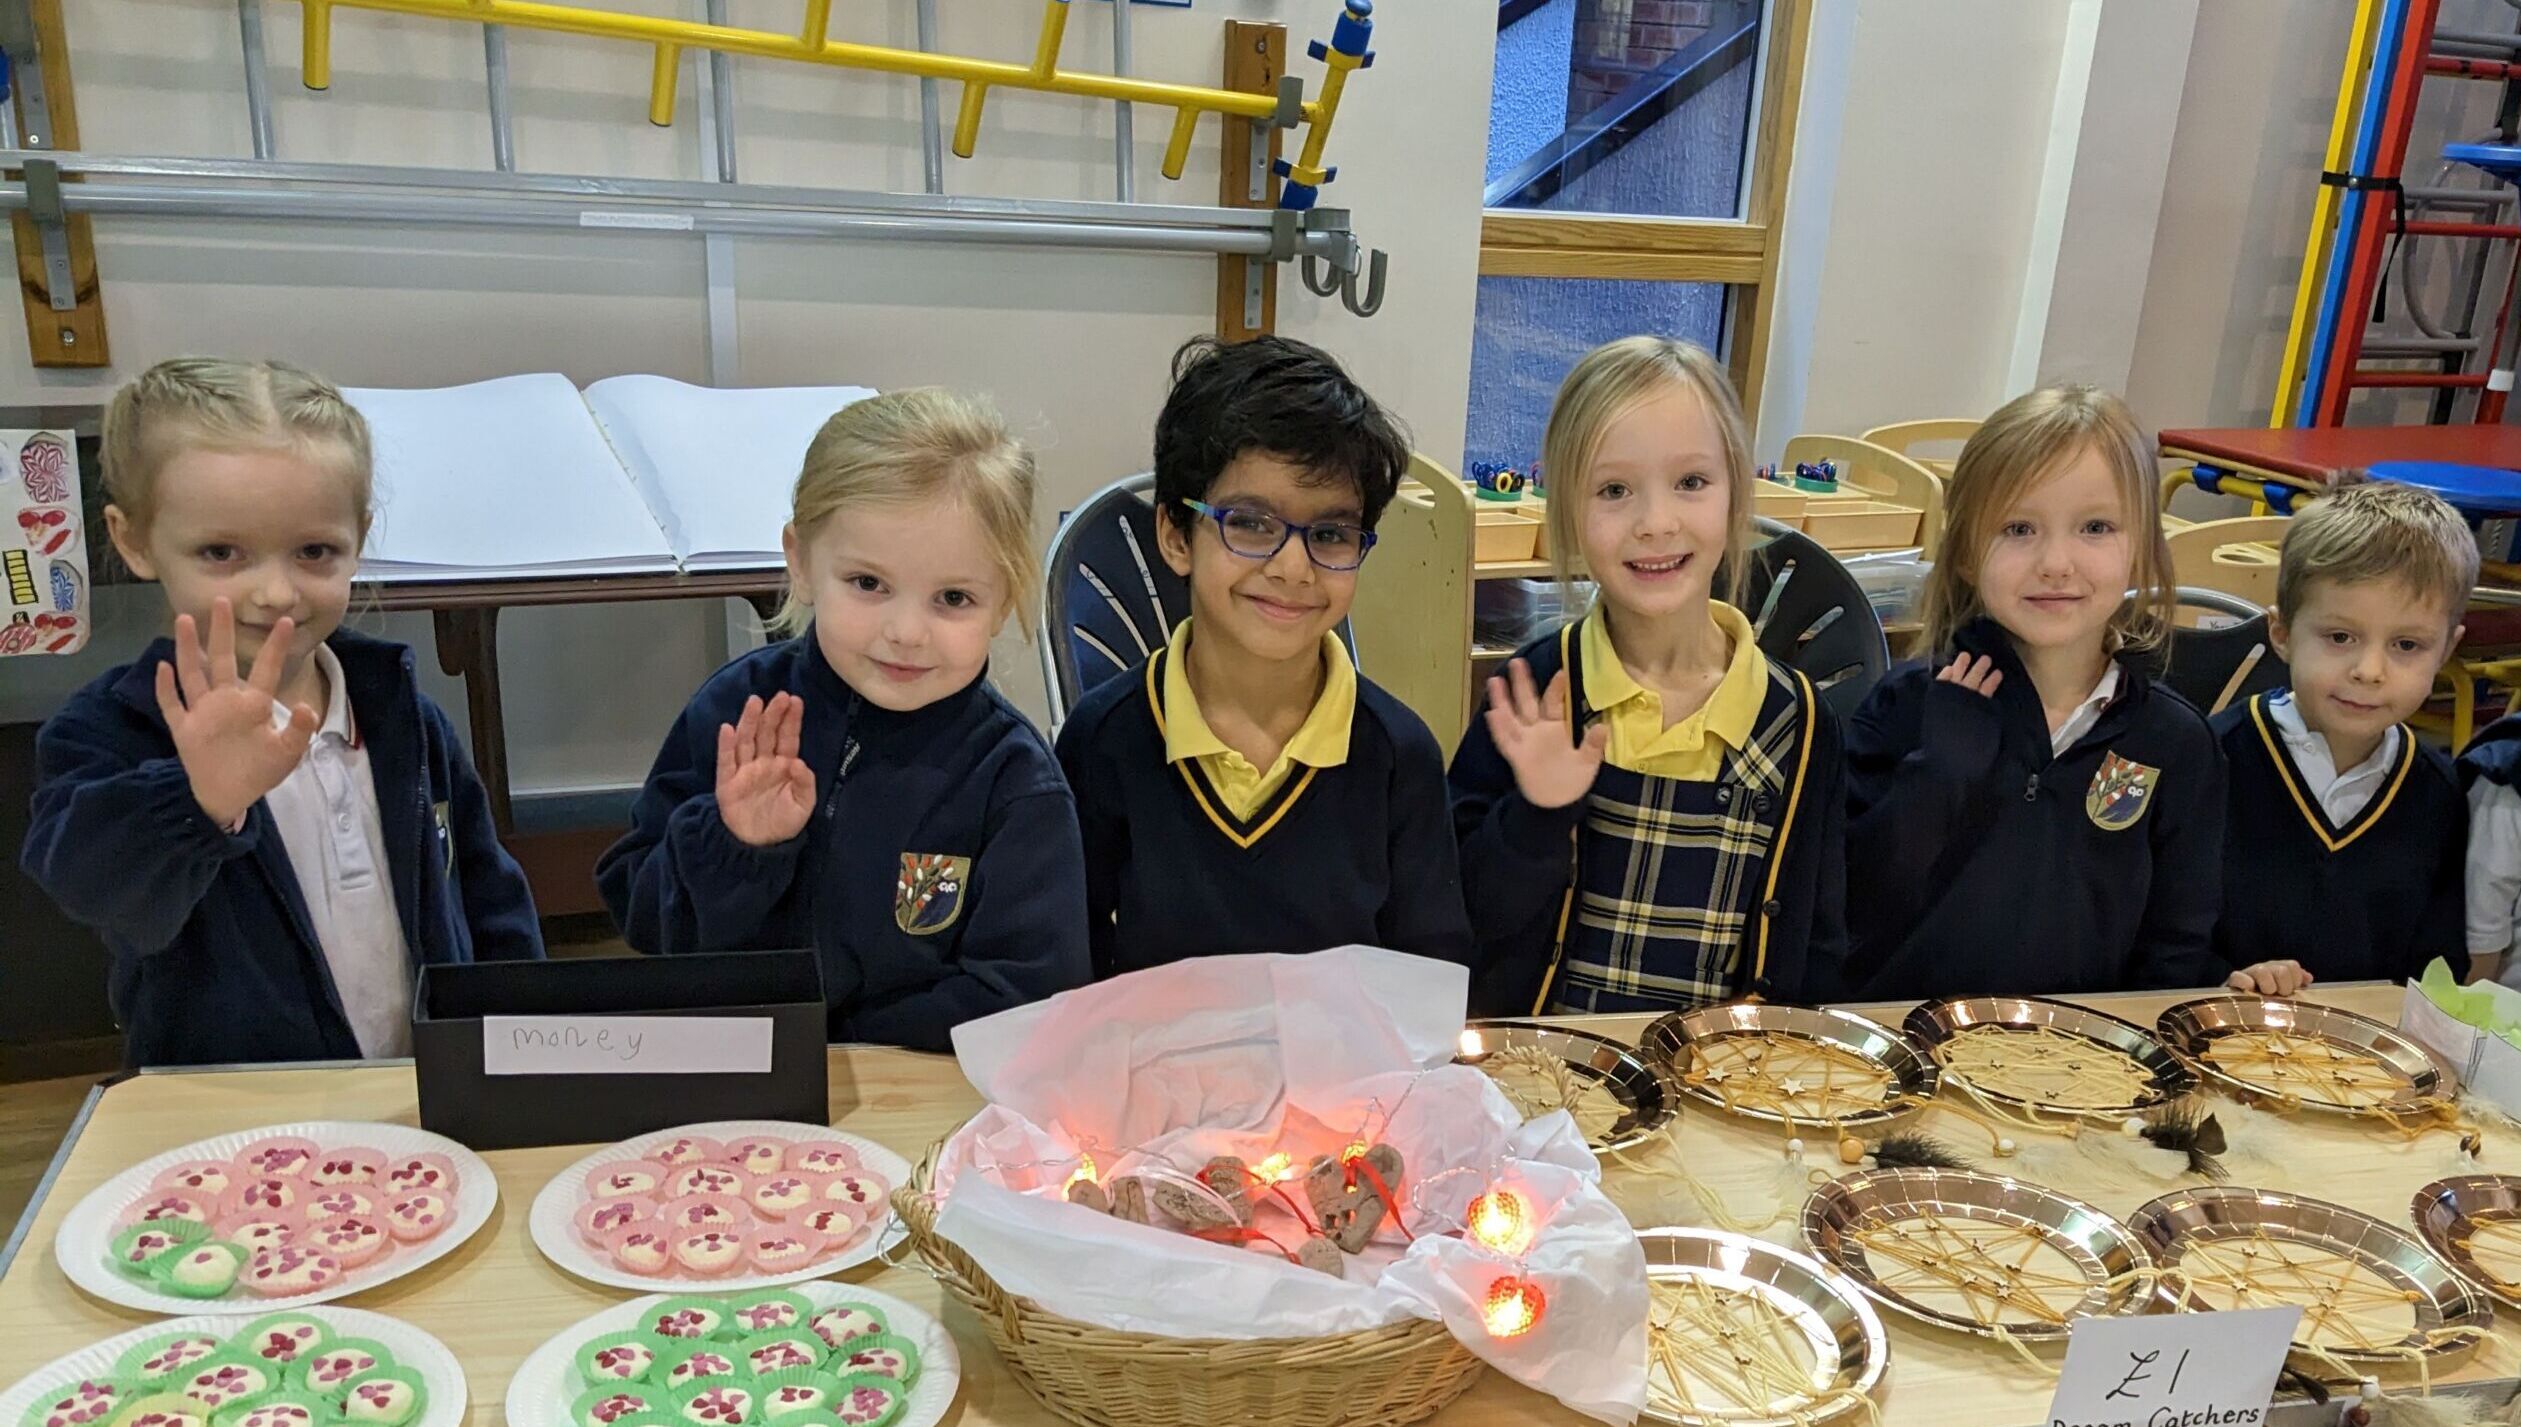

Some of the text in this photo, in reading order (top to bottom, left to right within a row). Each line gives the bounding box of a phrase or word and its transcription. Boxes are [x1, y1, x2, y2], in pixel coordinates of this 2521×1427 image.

[512, 1026, 643, 1061] money
[2105, 1348, 2190, 1400] £1
[2148, 1403, 2260, 1427] Catchers
